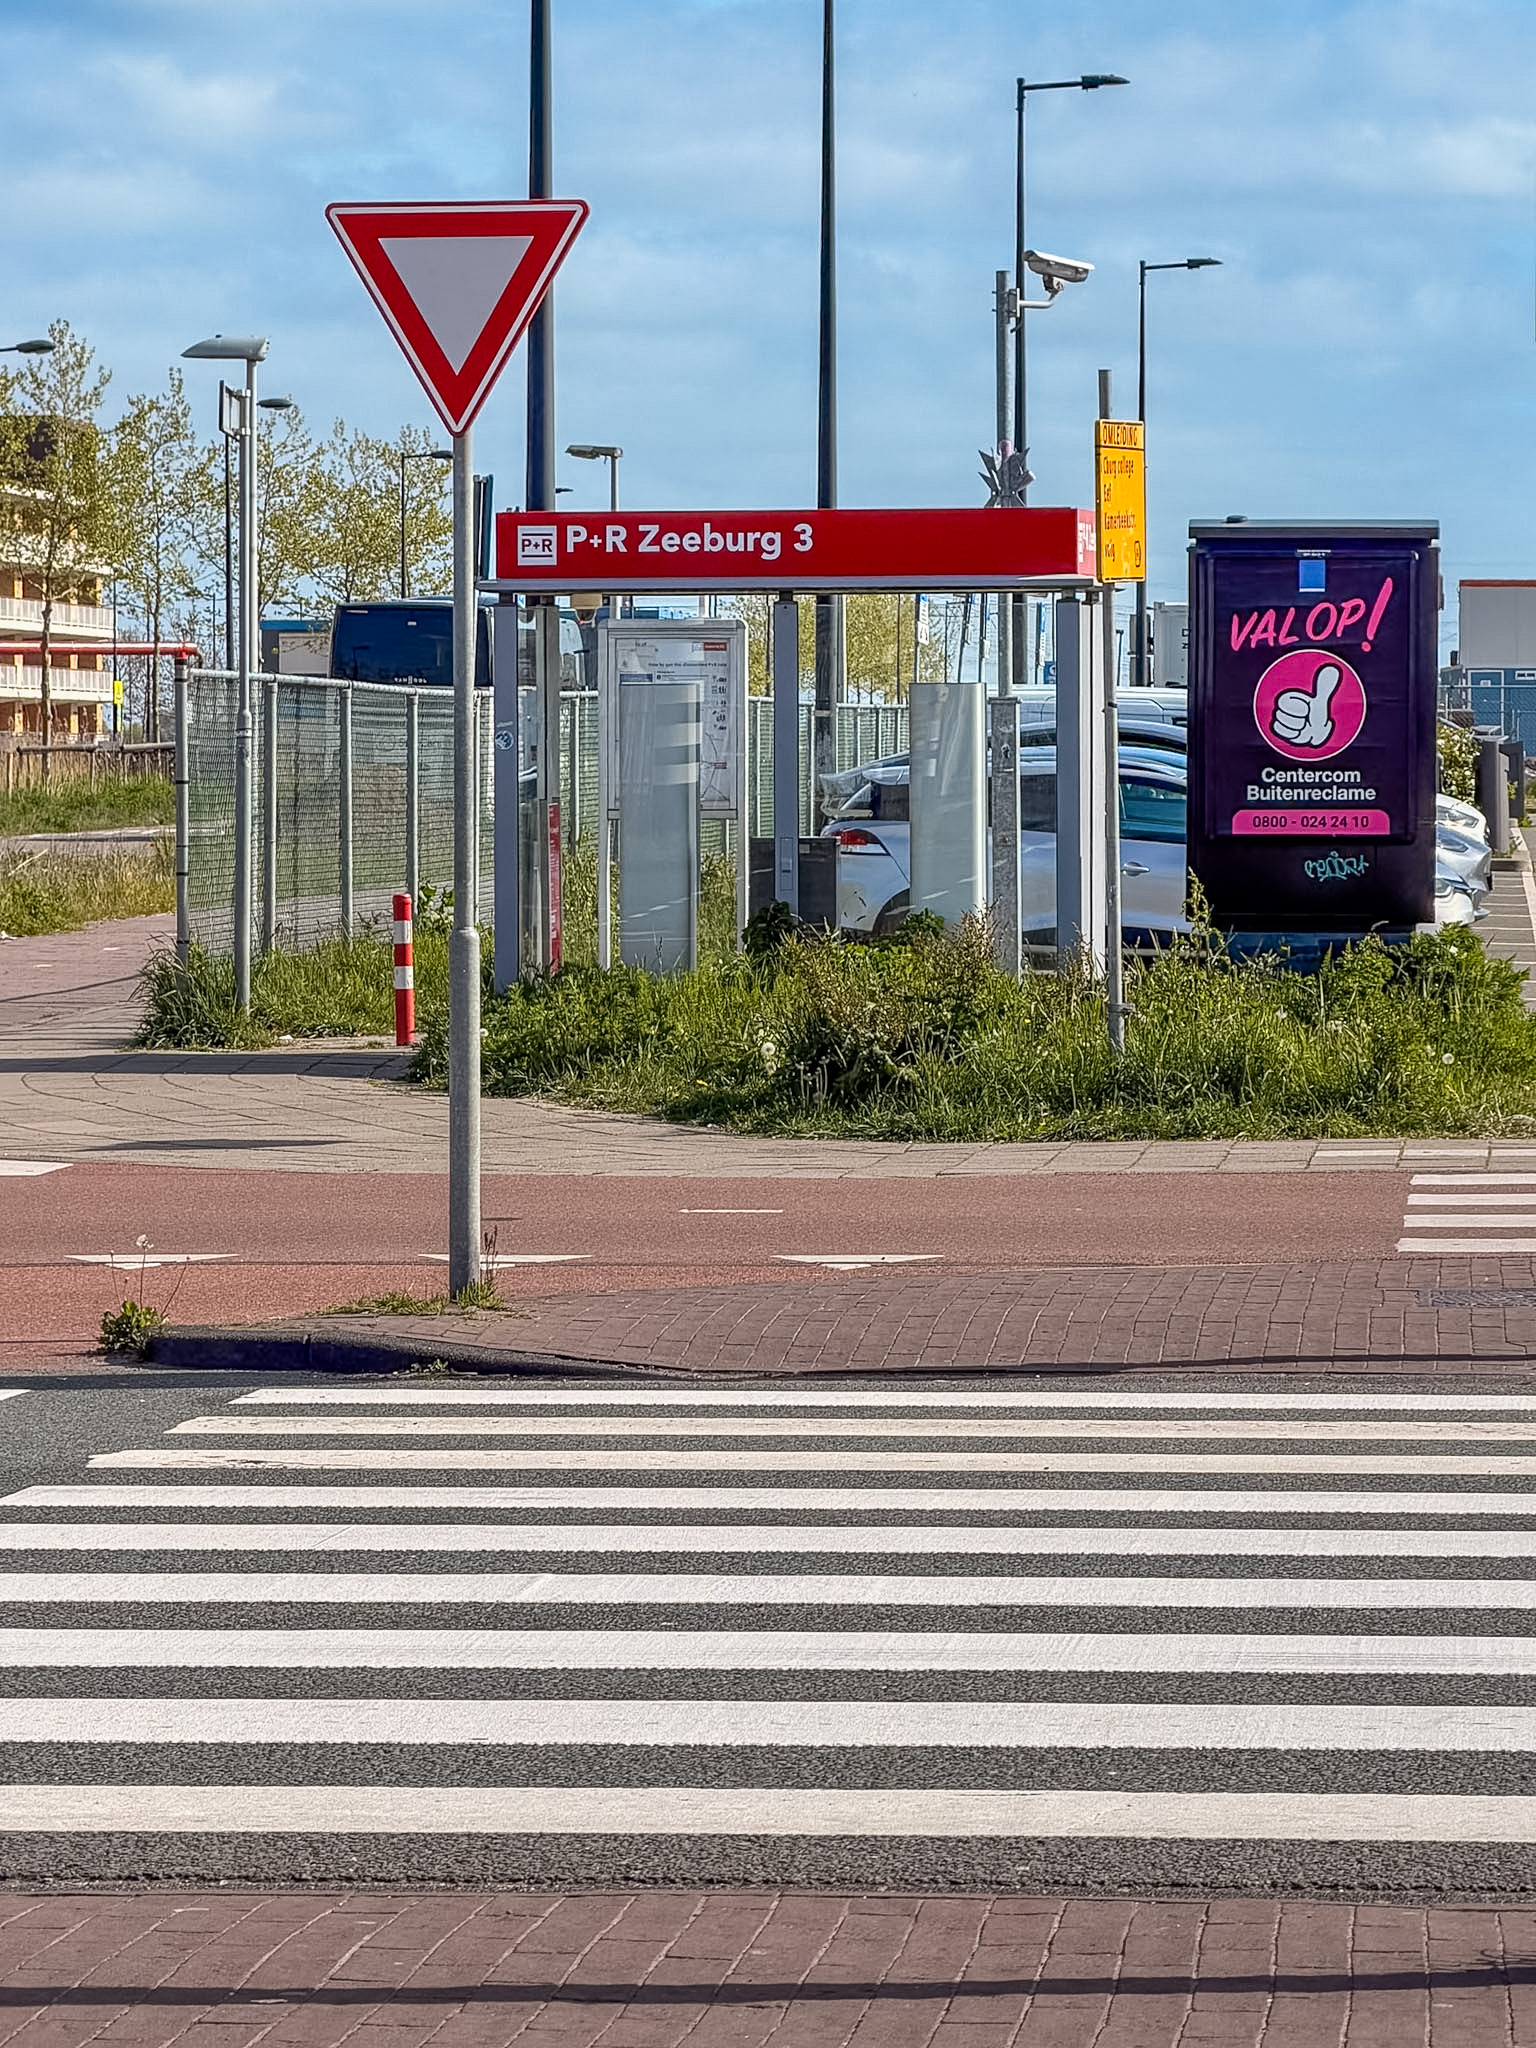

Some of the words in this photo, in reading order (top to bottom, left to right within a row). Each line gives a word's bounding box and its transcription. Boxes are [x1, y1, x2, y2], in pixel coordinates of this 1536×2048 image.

[1102, 424, 1138, 447] OMLEIDING
[521, 538, 553, 553] P+R
[566, 524, 628, 553] P+R
[638, 522, 781, 560] Zeeburg
[792, 523, 814, 552] 3
[1230, 606, 1300, 652] VAL
[1305, 576, 1394, 652] OP!
[1261, 767, 1362, 783] Centercom
[1246, 785, 1377, 801] Buitenreclame
[1252, 815, 1288, 828] 0800
[1300, 815, 1328, 828] 024
[1330, 815, 1348, 828] 24
[1353, 815, 1369, 828] 10
